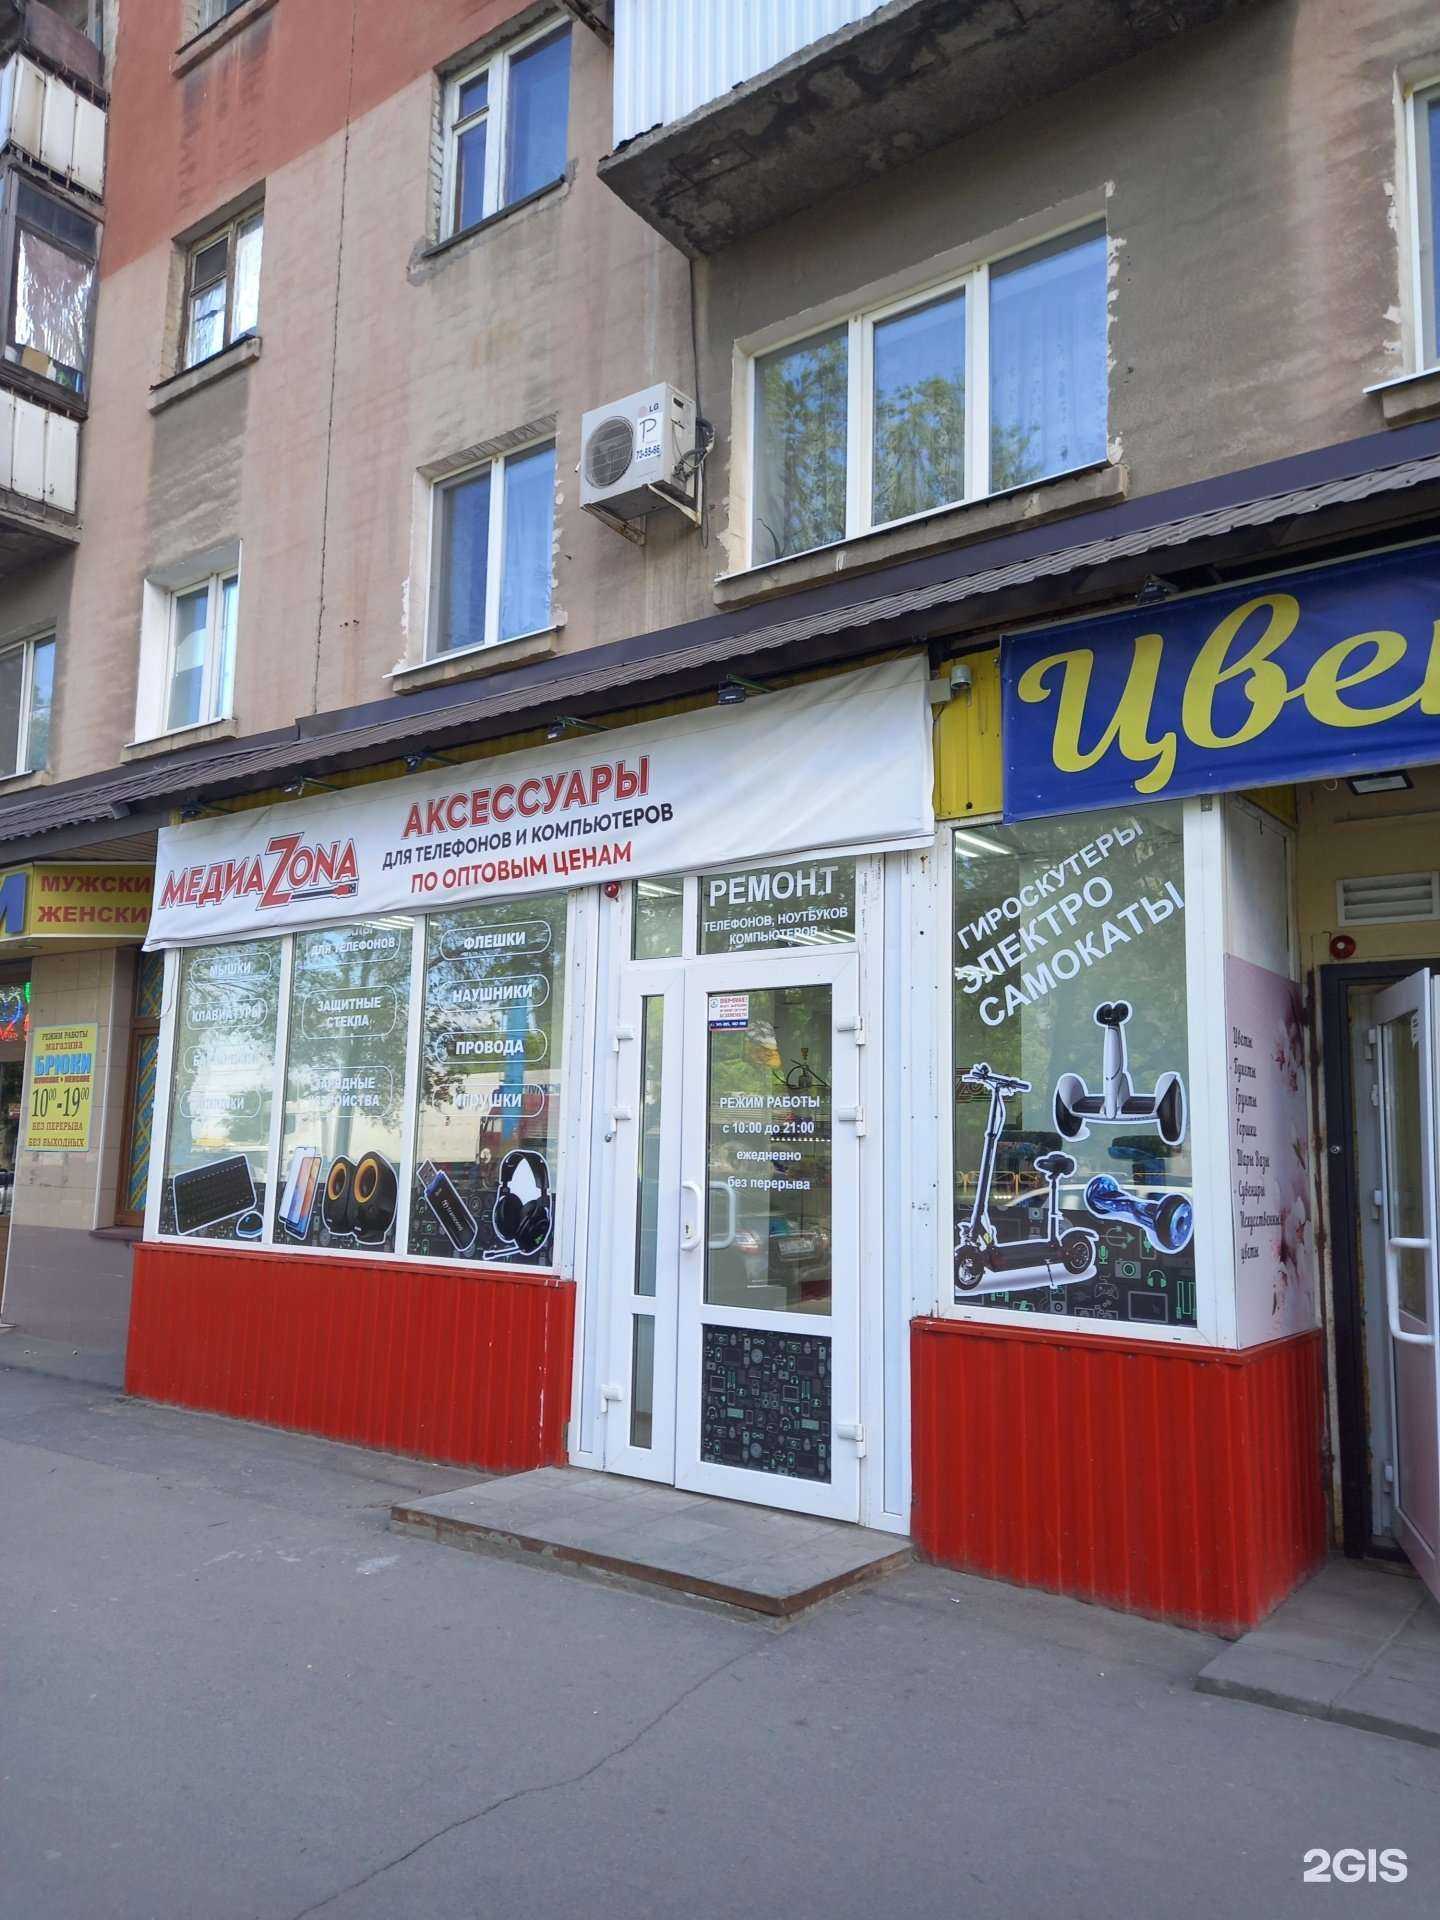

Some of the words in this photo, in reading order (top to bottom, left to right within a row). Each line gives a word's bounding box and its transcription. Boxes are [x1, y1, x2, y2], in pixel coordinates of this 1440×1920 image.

[649, 402, 659, 412] LG
[1017, 593, 1440, 794] Цве
[401, 755, 651, 840] АКСЕССУАРЫ
[383, 849, 413, 871] ДЛЯ
[415, 830, 513, 864] ТЕЛЕФОНОВ
[516, 827, 529, 846] И
[531, 802, 674, 844] КОМПЬЮТЕРОВ
[411, 870, 439, 894] ПО
[443, 857, 548, 892] ОПТОВЫМ
[553, 841, 633, 876] ЦЕНАМ
[709, 866, 838, 907] РЕМОНТ
[957, 816, 1145, 950] ГИРОСКУТЕРЫ
[703, 914, 775, 933] ТЕЛЕФОНОВ,
[777, 907, 848, 925] НОУТБУКОВ
[463, 931, 526, 950] ФЛЕШКИ
[729, 925, 818, 946] КОМПЬЮТЕРОВ
[962, 876, 1113, 994] ЭЛЕКТРО
[334, 937, 396, 954] ТЕЛЕФОНОВ
[979, 880, 1185, 1027] САМОКАТЫ
[209, 961, 251, 978] МЫШКИ
[452, 984, 533, 1003] НАУШНИКИ
[191, 1003, 262, 1023] КЛАВИАТУРЫ
[317, 996, 382, 1012] ЗАЩИТНЫЕ
[326, 1014, 370, 1029] СТЕКЛА
[455, 1039, 525, 1056] ПРОВОДА
[35, 1053, 92, 1076] БРЮКИ
[719, 1096, 764, 1109] РЕЖИМ
[766, 1095, 820, 1109] РАБОТЫ
[732, 1122, 762, 1134] 10:00
[765, 1123, 781, 1136] до
[783, 1121, 815, 1134] 21:00
[736, 1151, 802, 1163] ежедневно
[727, 1176, 747, 1189] без
[750, 1178, 811, 1193] перерыва
